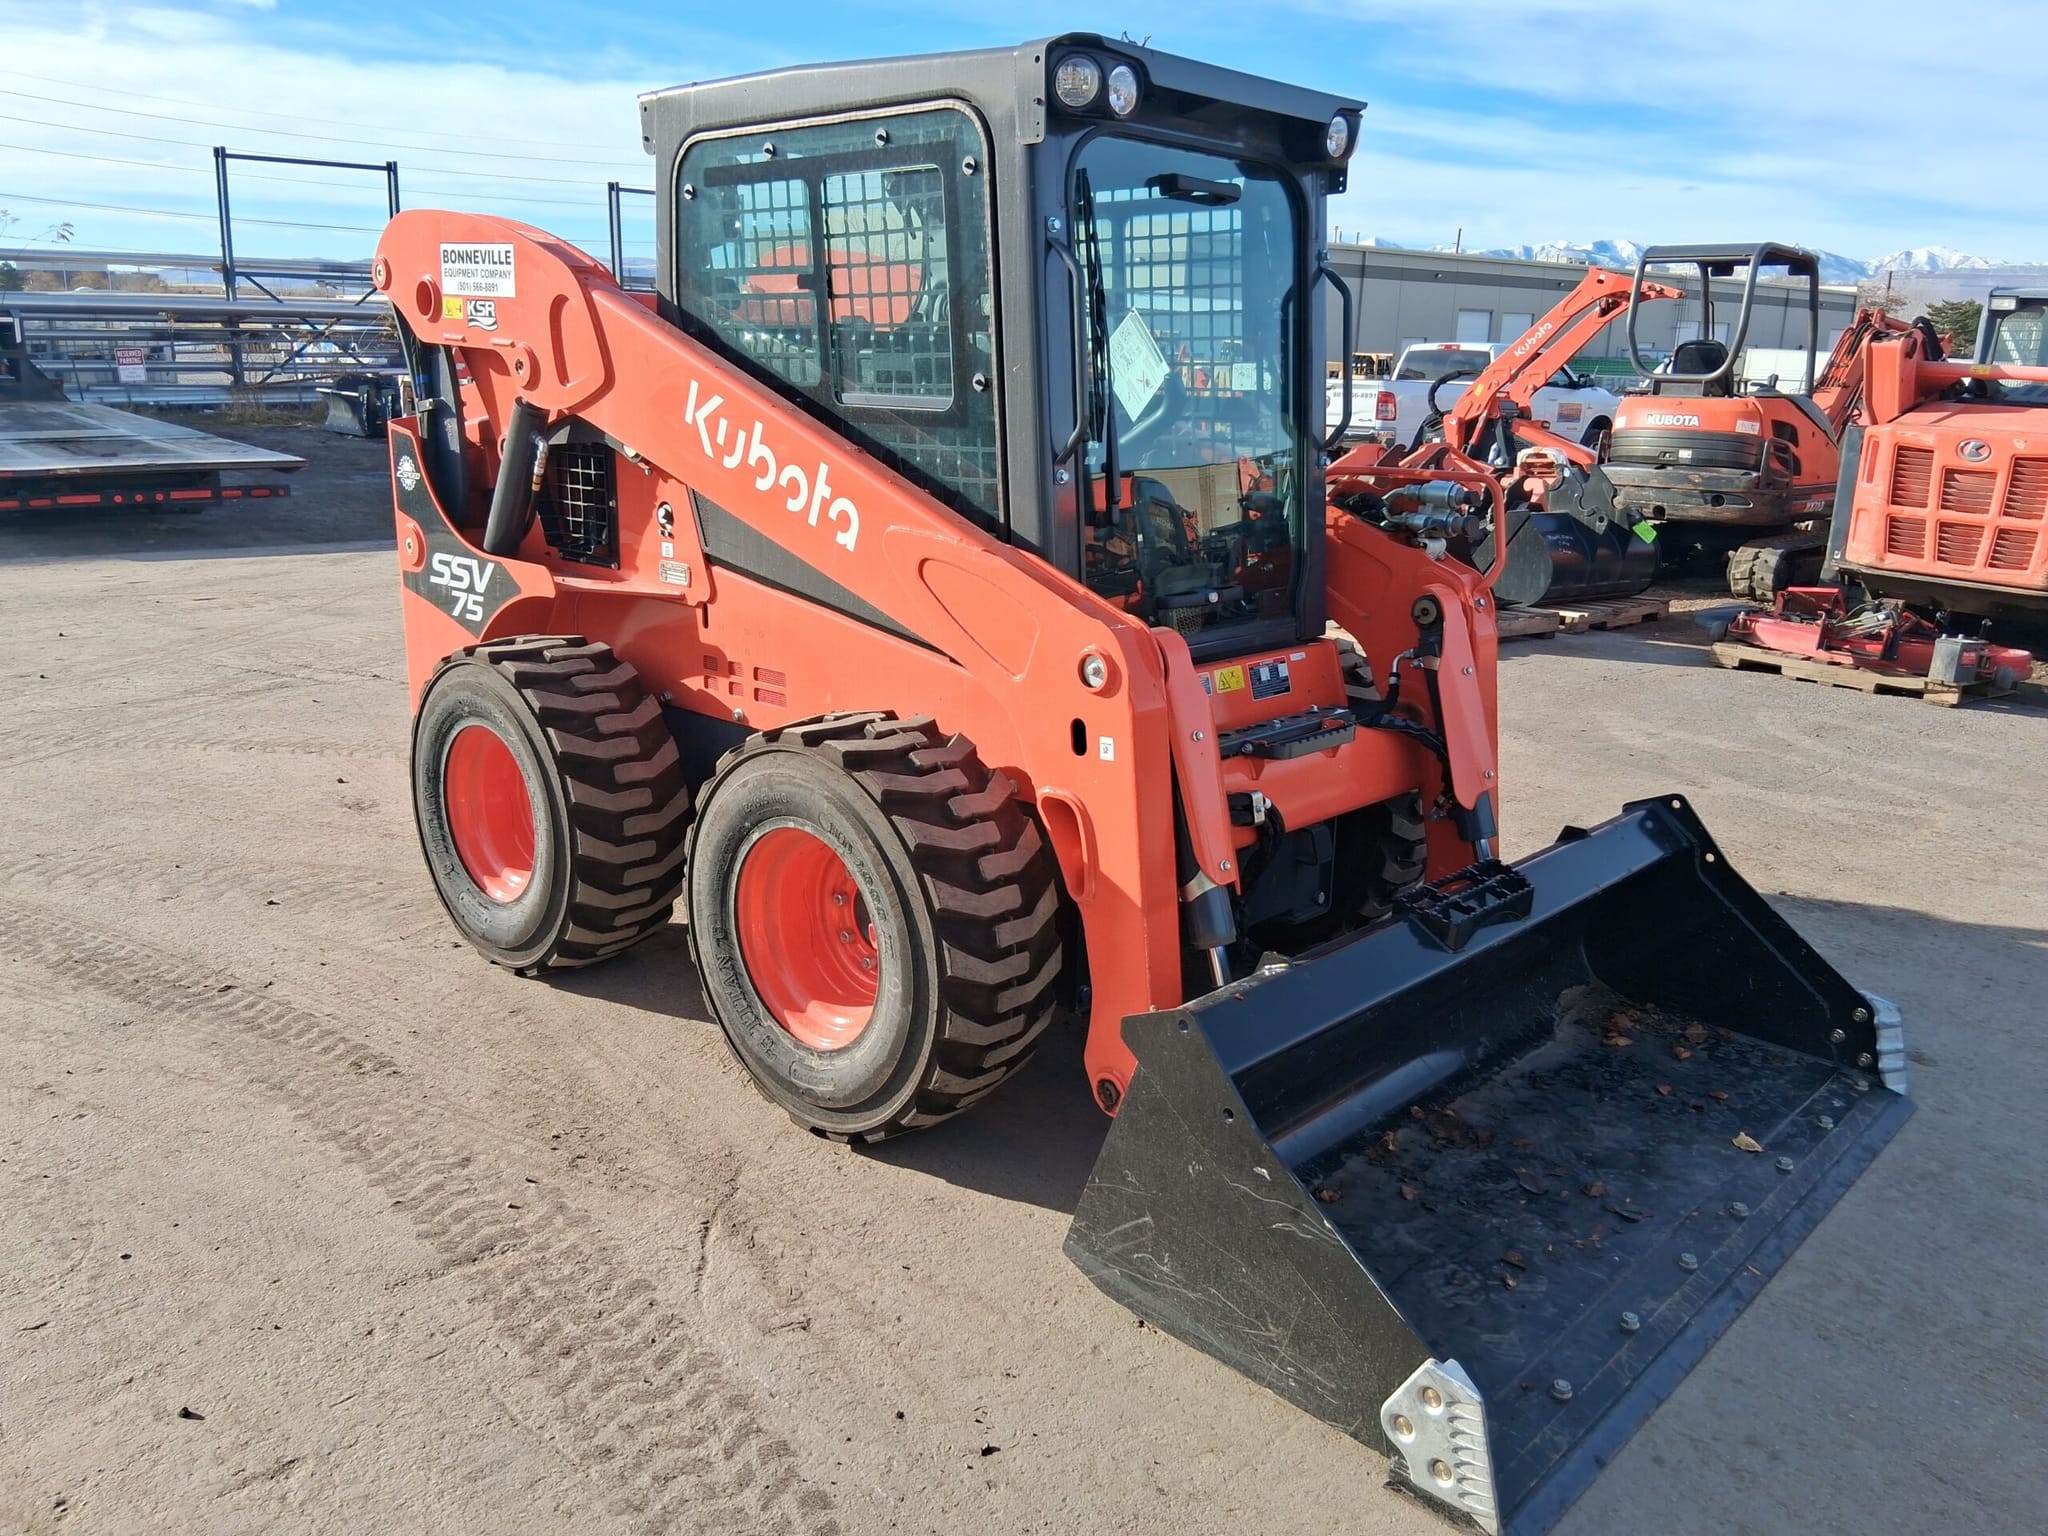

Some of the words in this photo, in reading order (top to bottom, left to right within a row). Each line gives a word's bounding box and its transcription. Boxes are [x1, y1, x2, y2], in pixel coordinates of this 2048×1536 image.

[443, 249, 512, 265] BONNEVILLE
[444, 267, 478, 278] EQUIPMENT
[480, 268, 512, 280] COMPANY
[467, 300, 496, 317] KSR
[1513, 322, 1553, 357] Kubota
[1647, 413, 1700, 427] KUBOTA
[685, 379, 860, 552] Kubota
[430, 552, 495, 593] SSV
[451, 590, 485, 622] 75
